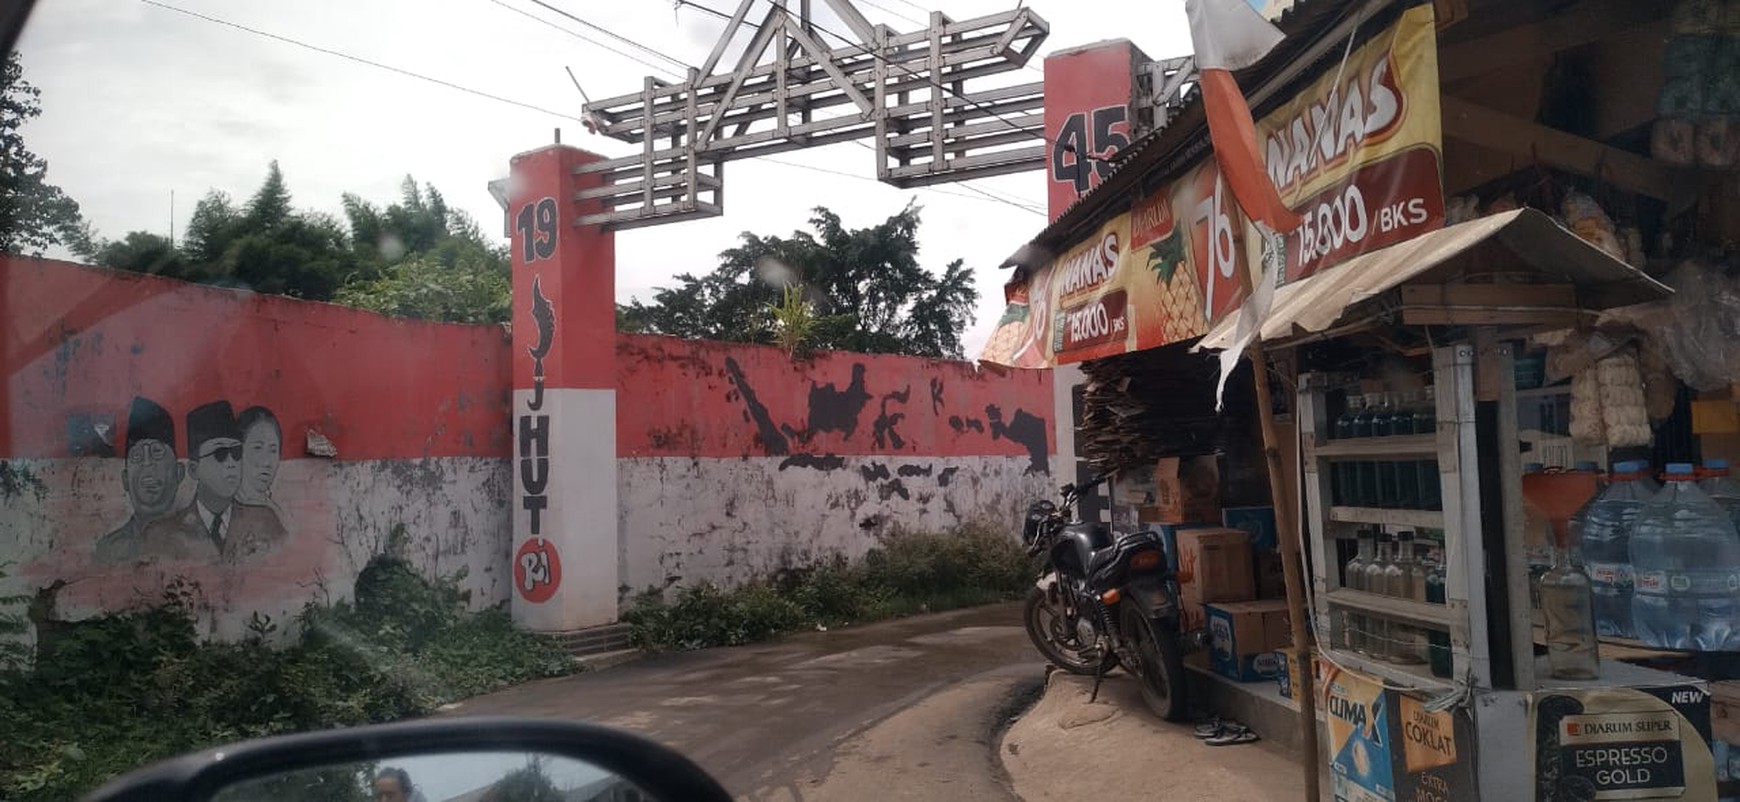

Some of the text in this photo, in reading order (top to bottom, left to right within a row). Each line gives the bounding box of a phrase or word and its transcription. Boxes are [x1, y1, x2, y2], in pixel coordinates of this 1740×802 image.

[1052, 104, 1130, 196] 45
[1267, 57, 1398, 190] NANAS
[515, 197, 558, 263] 19
[1196, 171, 1236, 322] 76
[1060, 233, 1120, 296] NANAS
[519, 414, 550, 535] HUT
[1635, 719, 1673, 732] SUPER
[1671, 691, 1704, 704] NEW
[1405, 721, 1452, 757] COKLAT
[1576, 746, 1668, 768] ESPRESSO
[1596, 768, 1651, 785] GOLD
